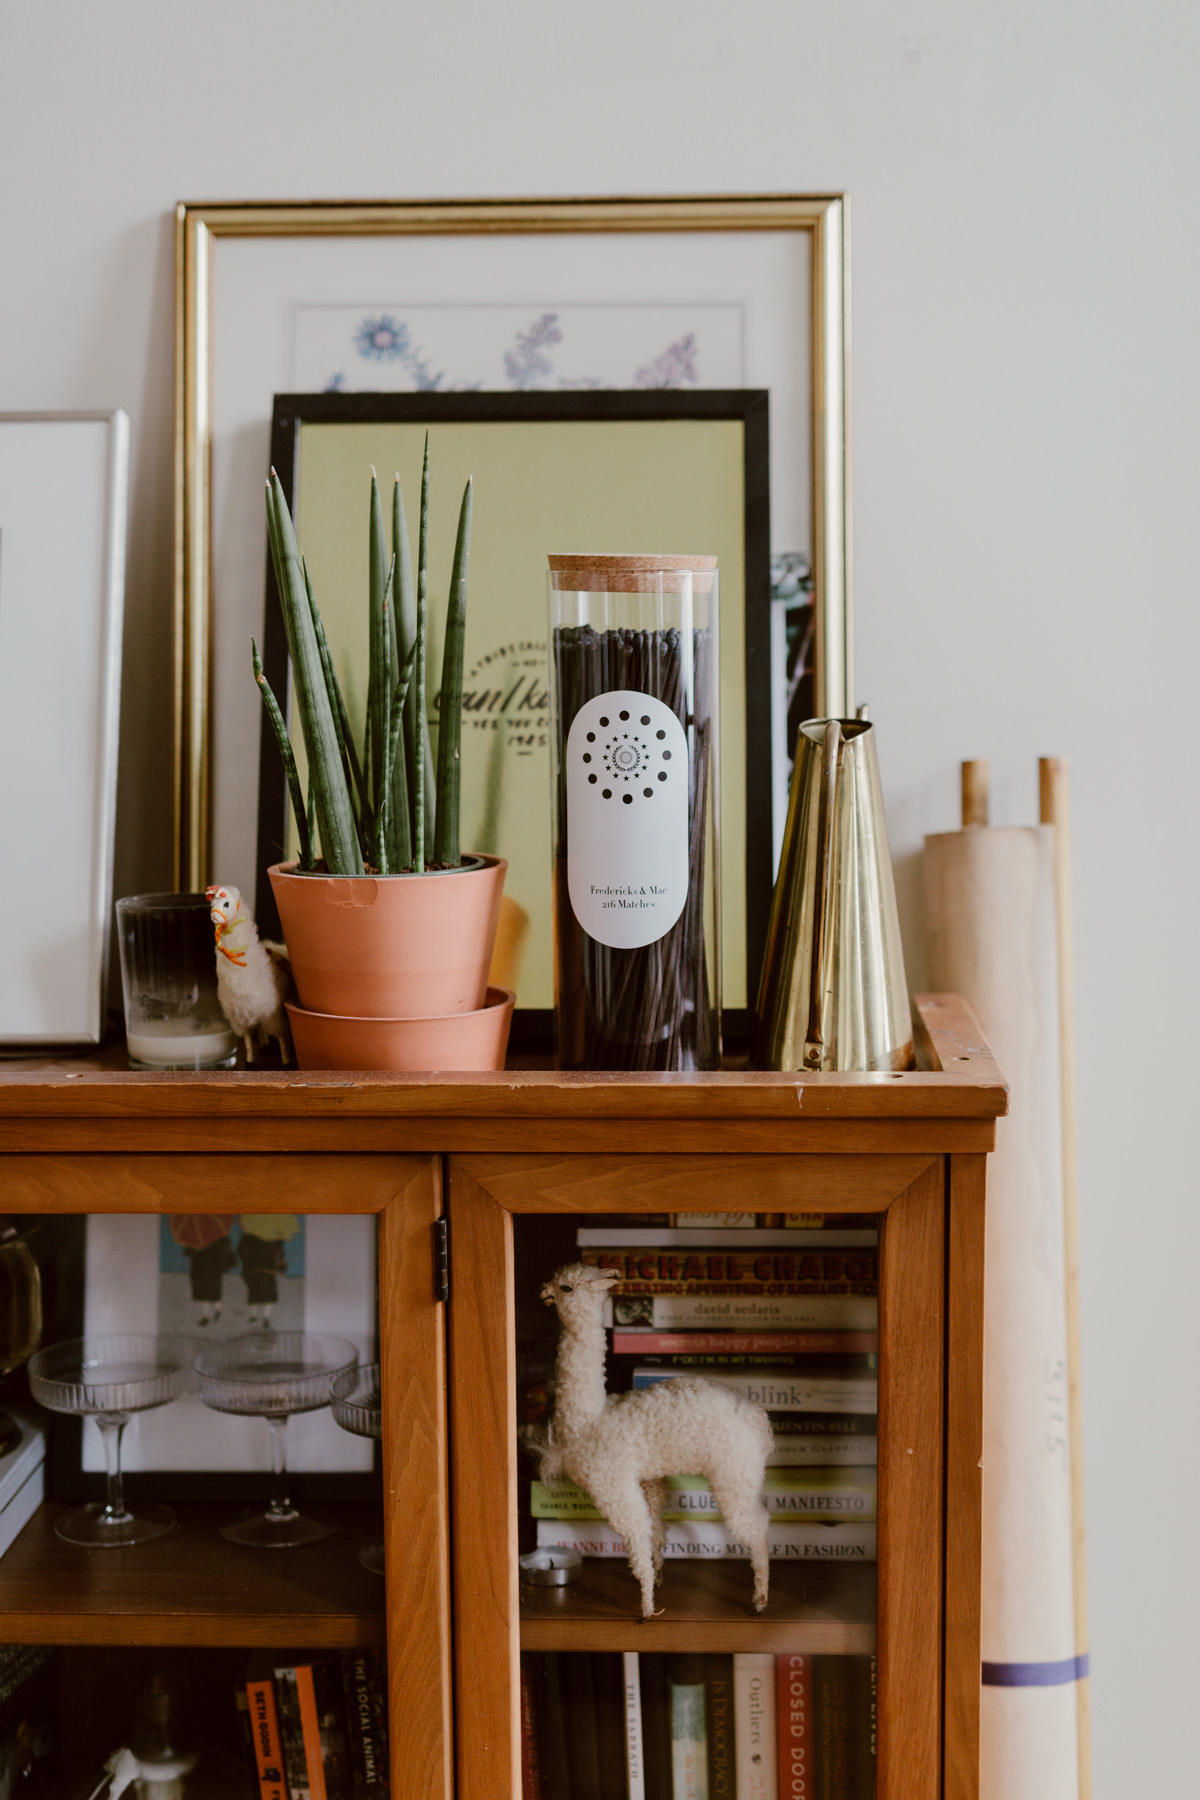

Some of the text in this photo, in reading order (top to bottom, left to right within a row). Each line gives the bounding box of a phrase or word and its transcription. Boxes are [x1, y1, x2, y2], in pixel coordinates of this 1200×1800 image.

[590, 885, 668, 896] Fredericks & Mac
[601, 899, 656, 909] 216 Matches
[598, 1255, 744, 1281] MICHAEL
[694, 1302, 780, 1314] david sedaris
[708, 1335, 750, 1349] happy
[752, 1336, 796, 1349] people
[746, 1384, 802, 1405] blink
[775, 1496, 865, 1510] MANIFESTO
[662, 1543, 866, 1557] FINDING MYSF IN FASHION
[789, 1655, 805, 1738] CLOSED
[354, 1658, 376, 1785] THE SOCIAL ANIMAL
[750, 1677, 764, 1745] Outliers
[254, 1690, 272, 1757] SETH GODIN
[625, 1684, 639, 1779] THE SABBATH
[712, 1697, 729, 1797] DEMOCRACY
